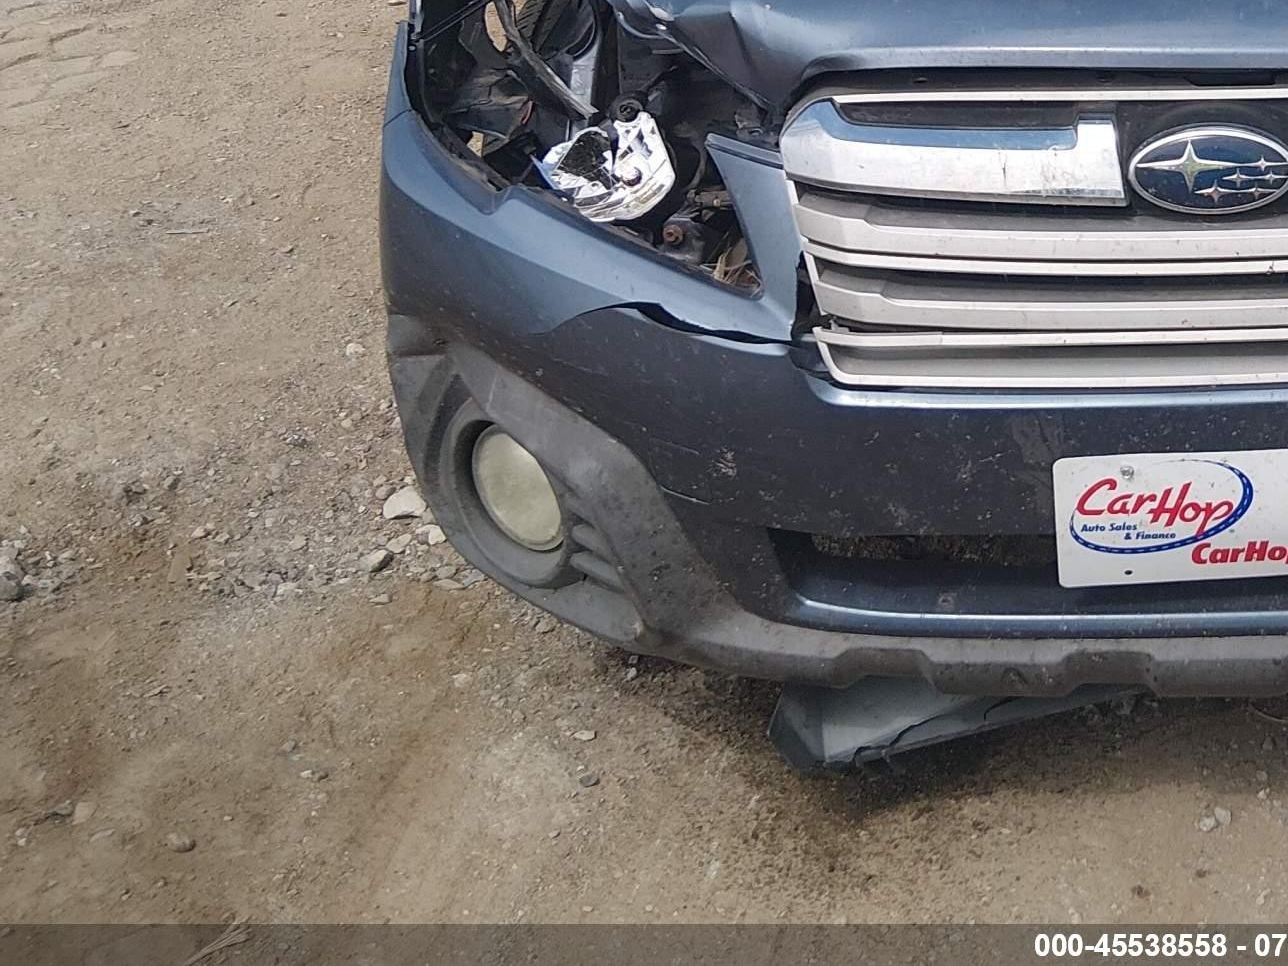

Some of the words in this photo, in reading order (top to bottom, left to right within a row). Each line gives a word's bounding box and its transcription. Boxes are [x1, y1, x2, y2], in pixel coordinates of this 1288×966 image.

[1075, 478, 1234, 537] CarHop
[1081, 523, 1106, 533] Auto
[1108, 522, 1138, 531] Sales
[1124, 532, 1132, 540] &
[1135, 531, 1176, 541] Finance
